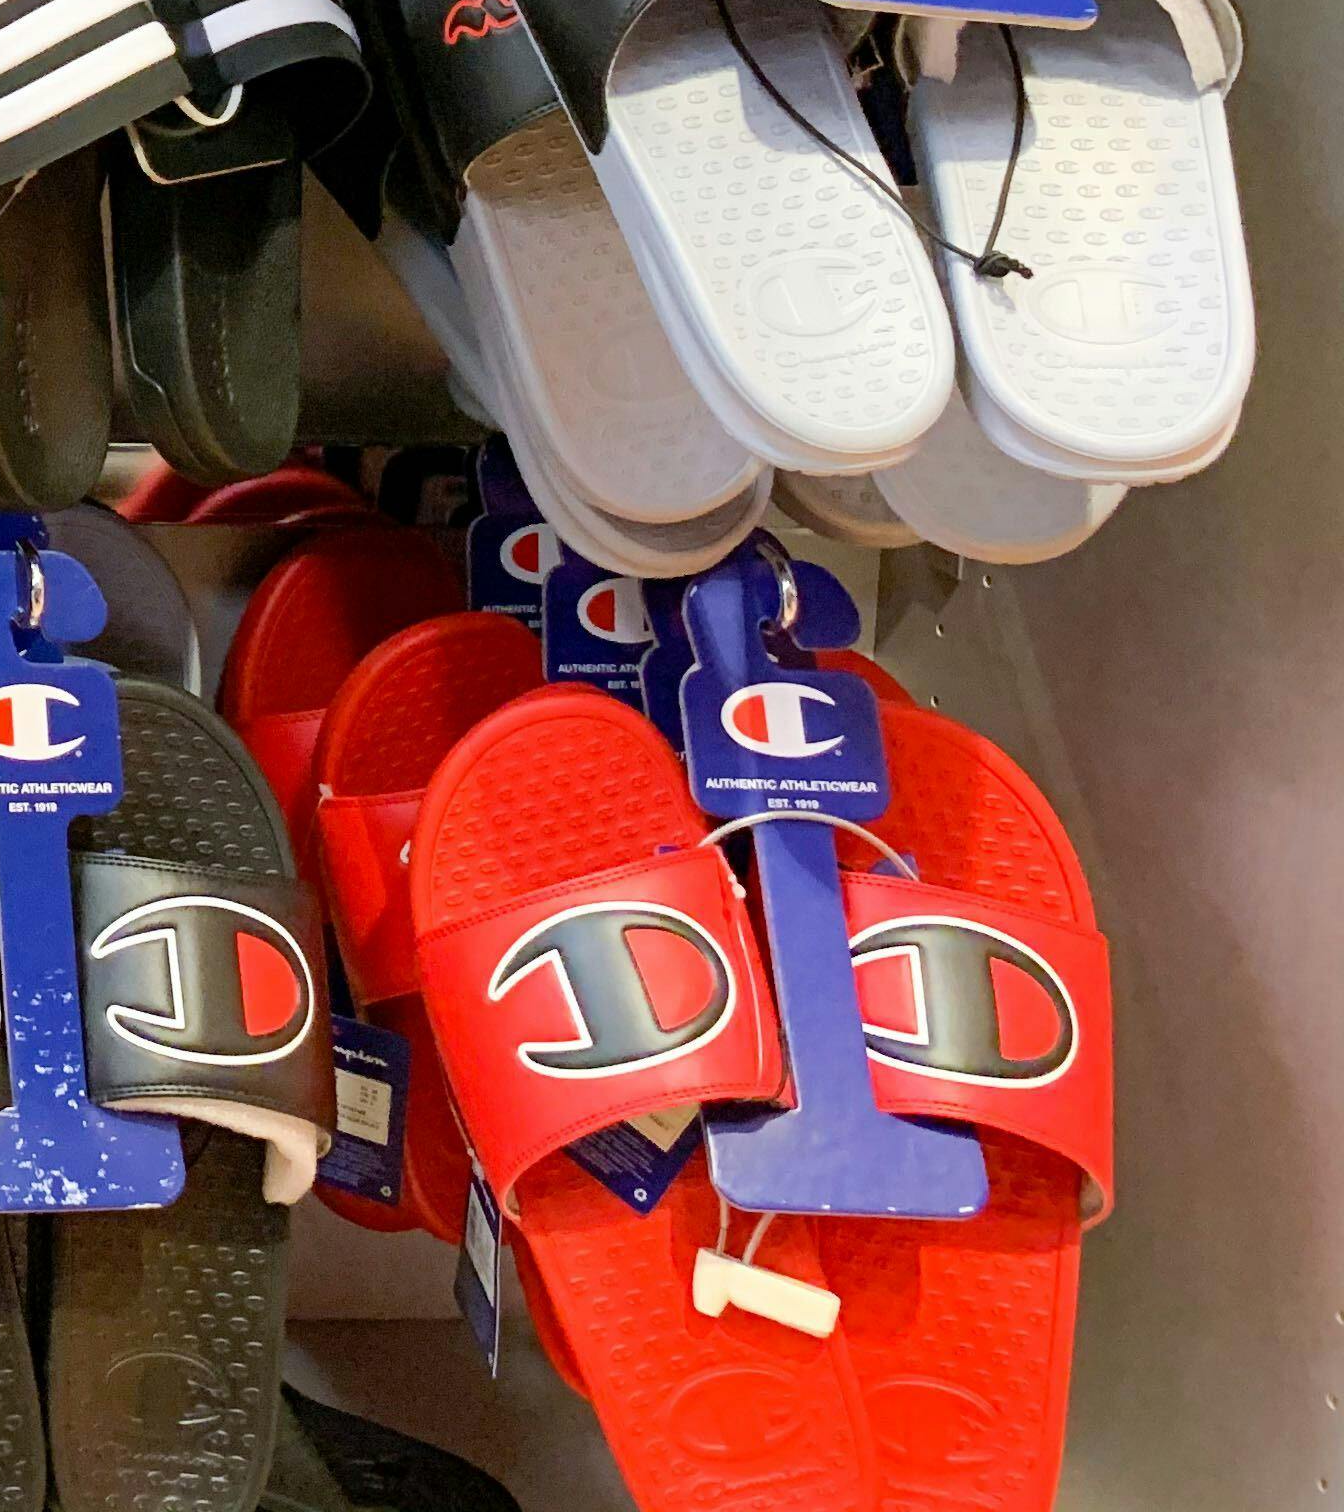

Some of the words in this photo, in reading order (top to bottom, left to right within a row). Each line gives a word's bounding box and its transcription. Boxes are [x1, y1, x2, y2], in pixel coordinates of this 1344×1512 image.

[557, 663, 617, 674] AUTHENTIC
[20, 781, 113, 795] ATHLETICWEAR
[705, 777, 778, 792] AUTHENTIC
[779, 779, 878, 794] ATHLETICWEAR
[8, 801, 33, 814] EST.
[33, 801, 58, 814] 1919
[767, 797, 793, 809] EST.
[794, 799, 820, 810] 1919
